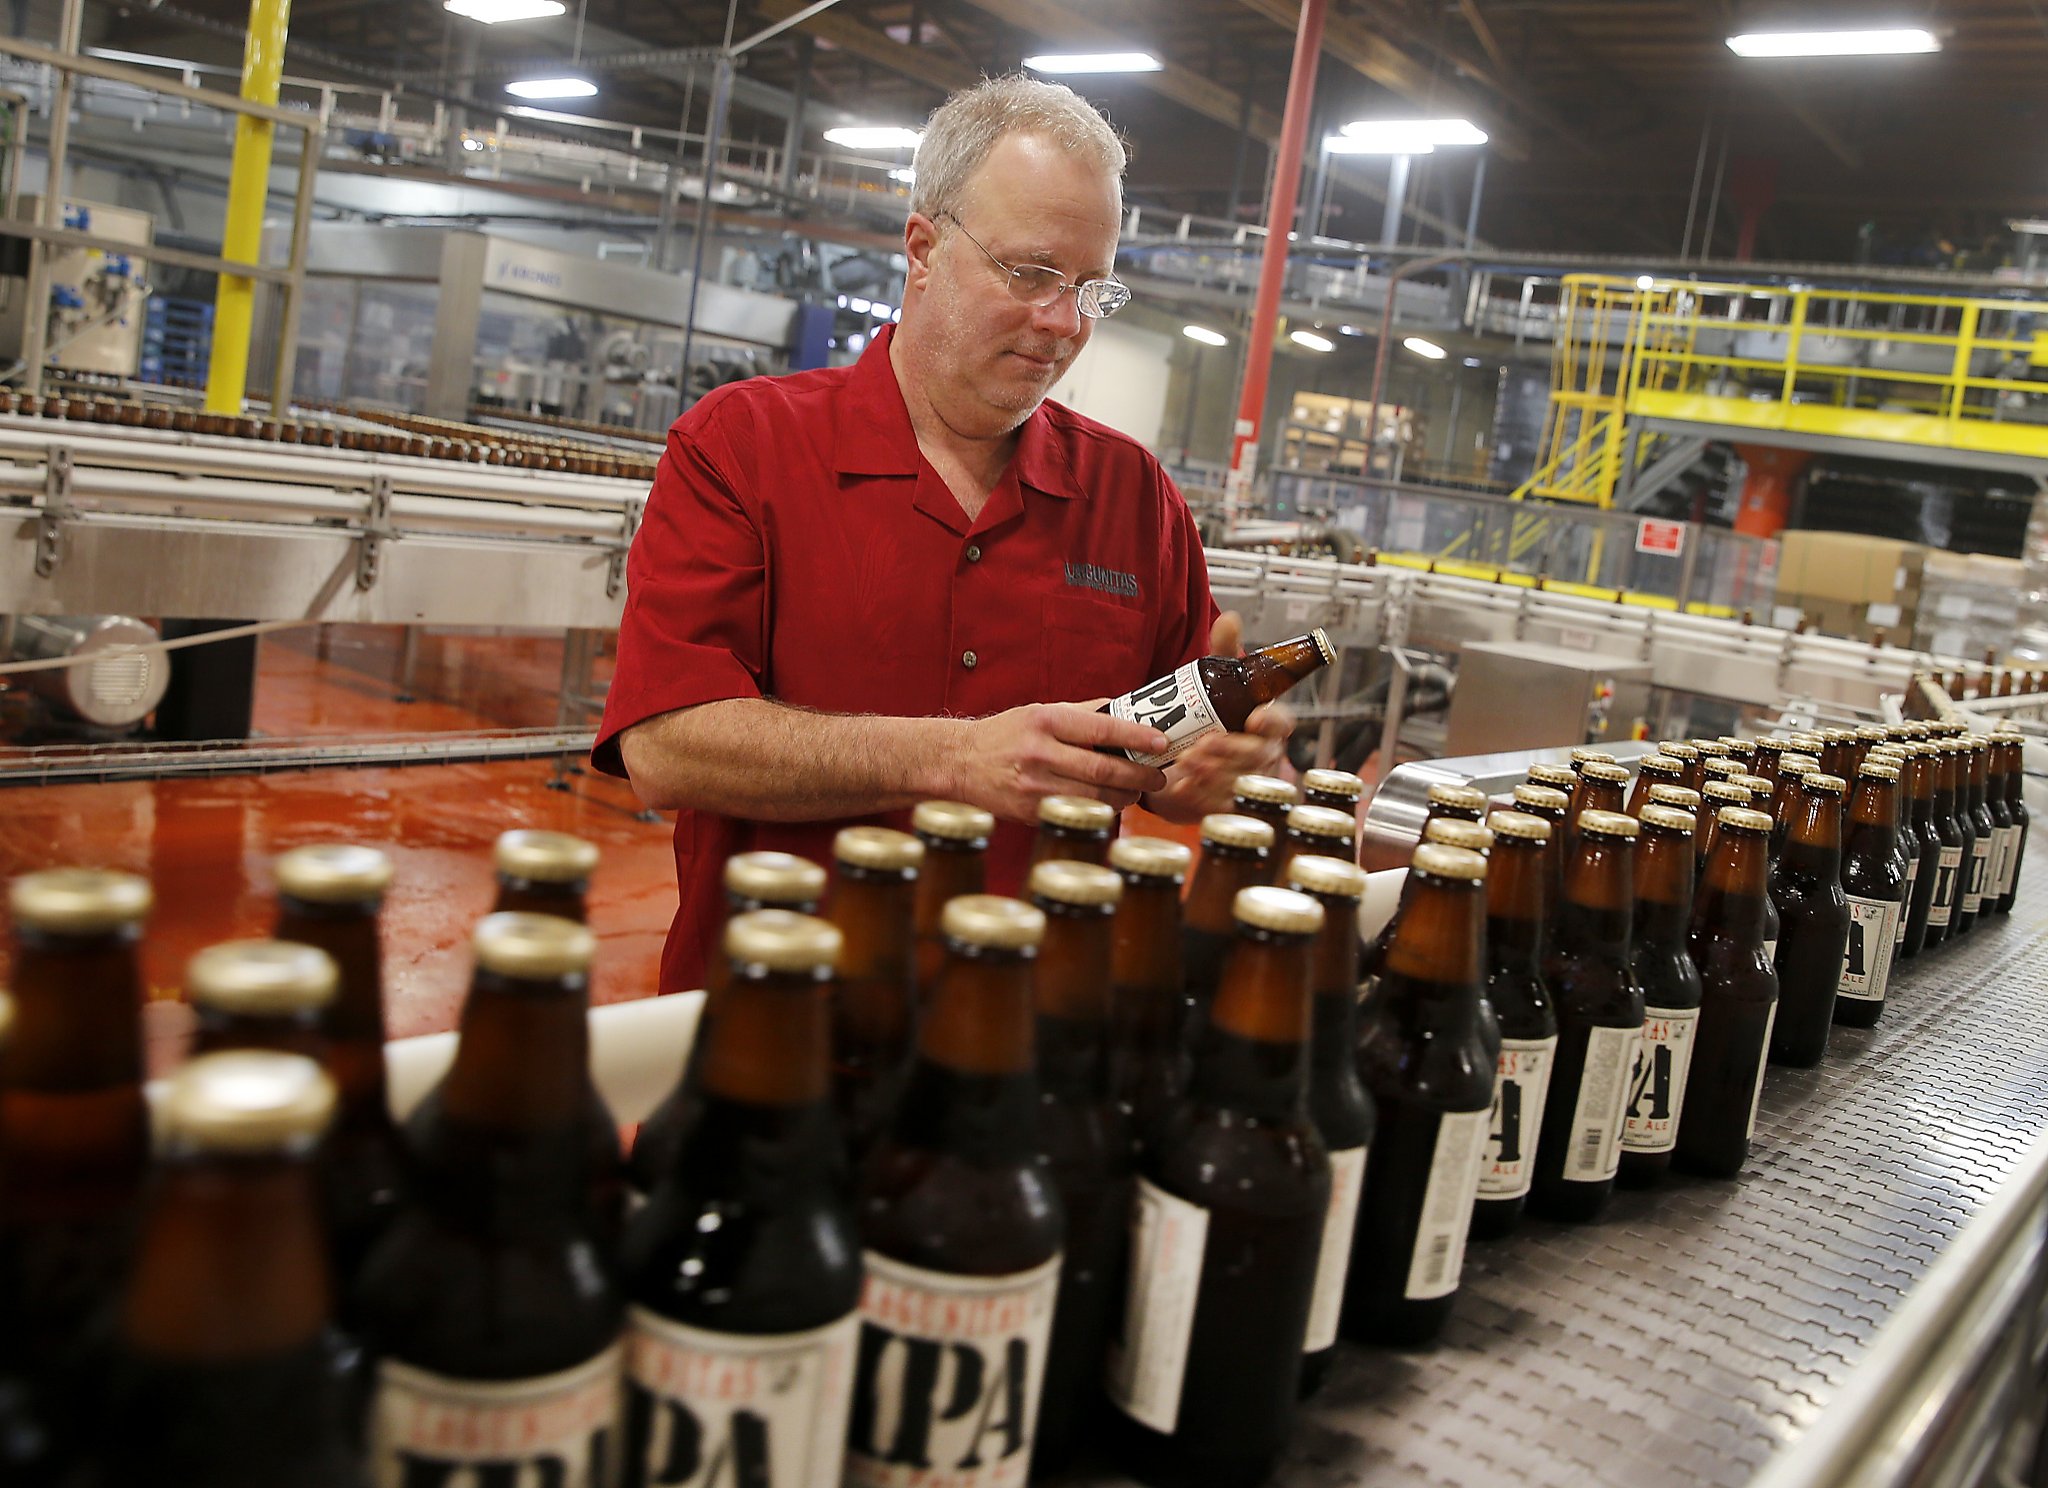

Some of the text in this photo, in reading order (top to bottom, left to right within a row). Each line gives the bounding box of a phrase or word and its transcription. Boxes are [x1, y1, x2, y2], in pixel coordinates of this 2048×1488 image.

[1129, 672, 1188, 734] PA
[1842, 973, 1865, 984] ALE
[1644, 1120, 1669, 1131] ALE
[1492, 1162, 1520, 1175] ALE
[848, 1320, 1031, 1470] IPA
[622, 1372, 772, 1488] PA
